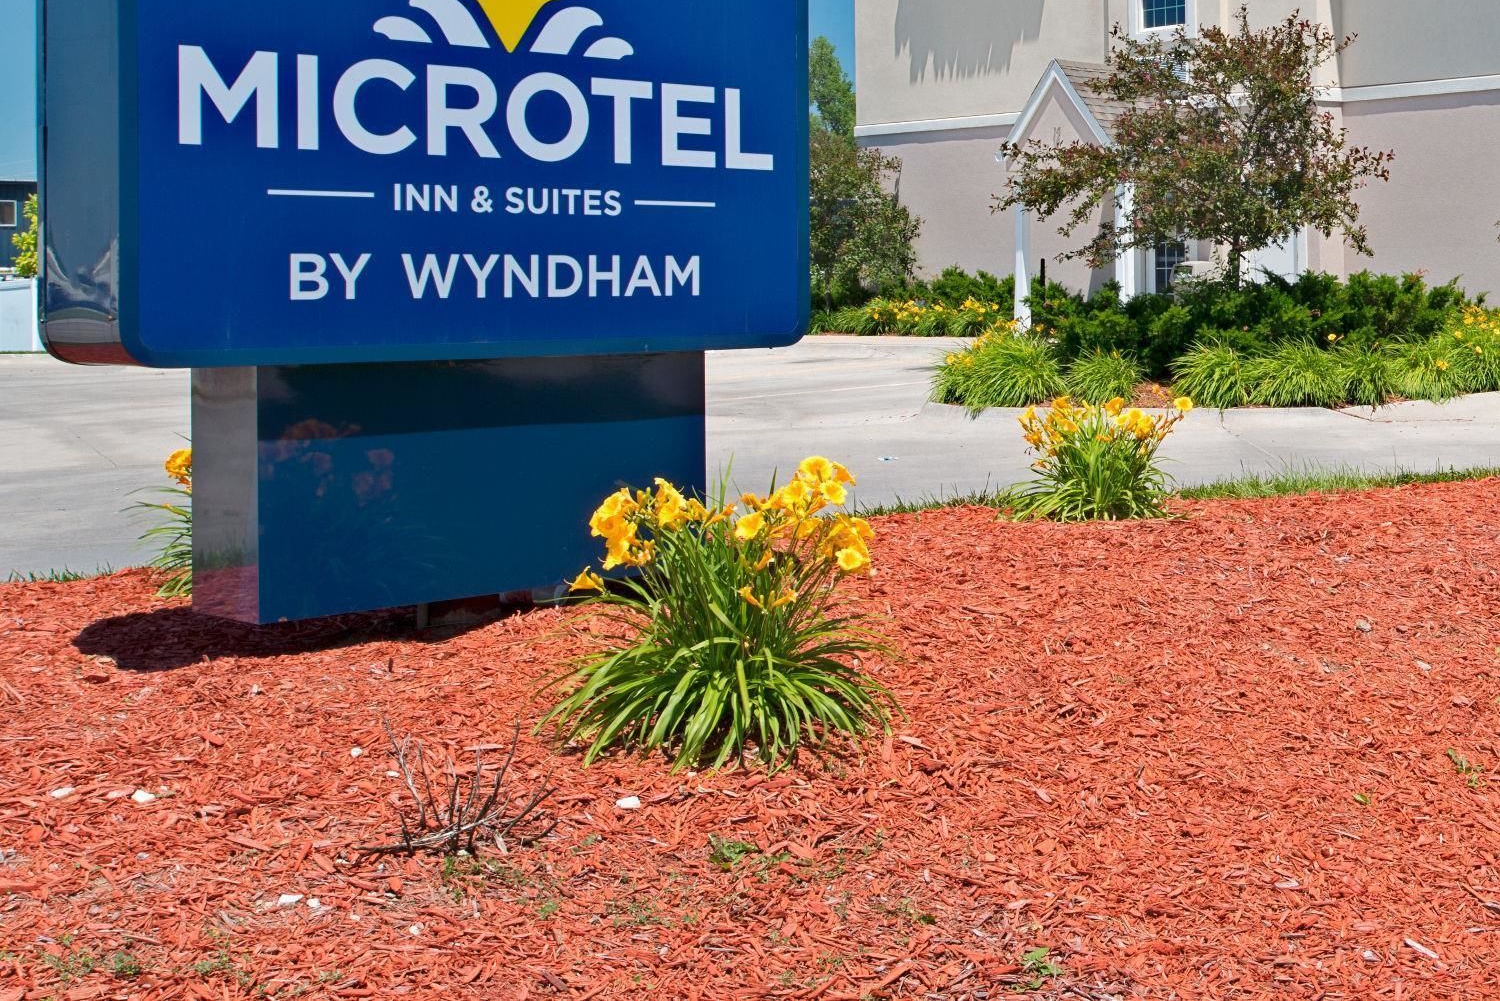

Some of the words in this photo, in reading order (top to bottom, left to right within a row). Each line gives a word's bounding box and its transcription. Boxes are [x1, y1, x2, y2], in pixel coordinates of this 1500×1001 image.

[178, 44, 774, 172] MICROTEL
[394, 183, 458, 213] INN
[470, 185, 494, 214] &
[505, 187, 623, 217] SUITES
[289, 253, 372, 301] BY
[401, 253, 702, 300] WYNDHAM
